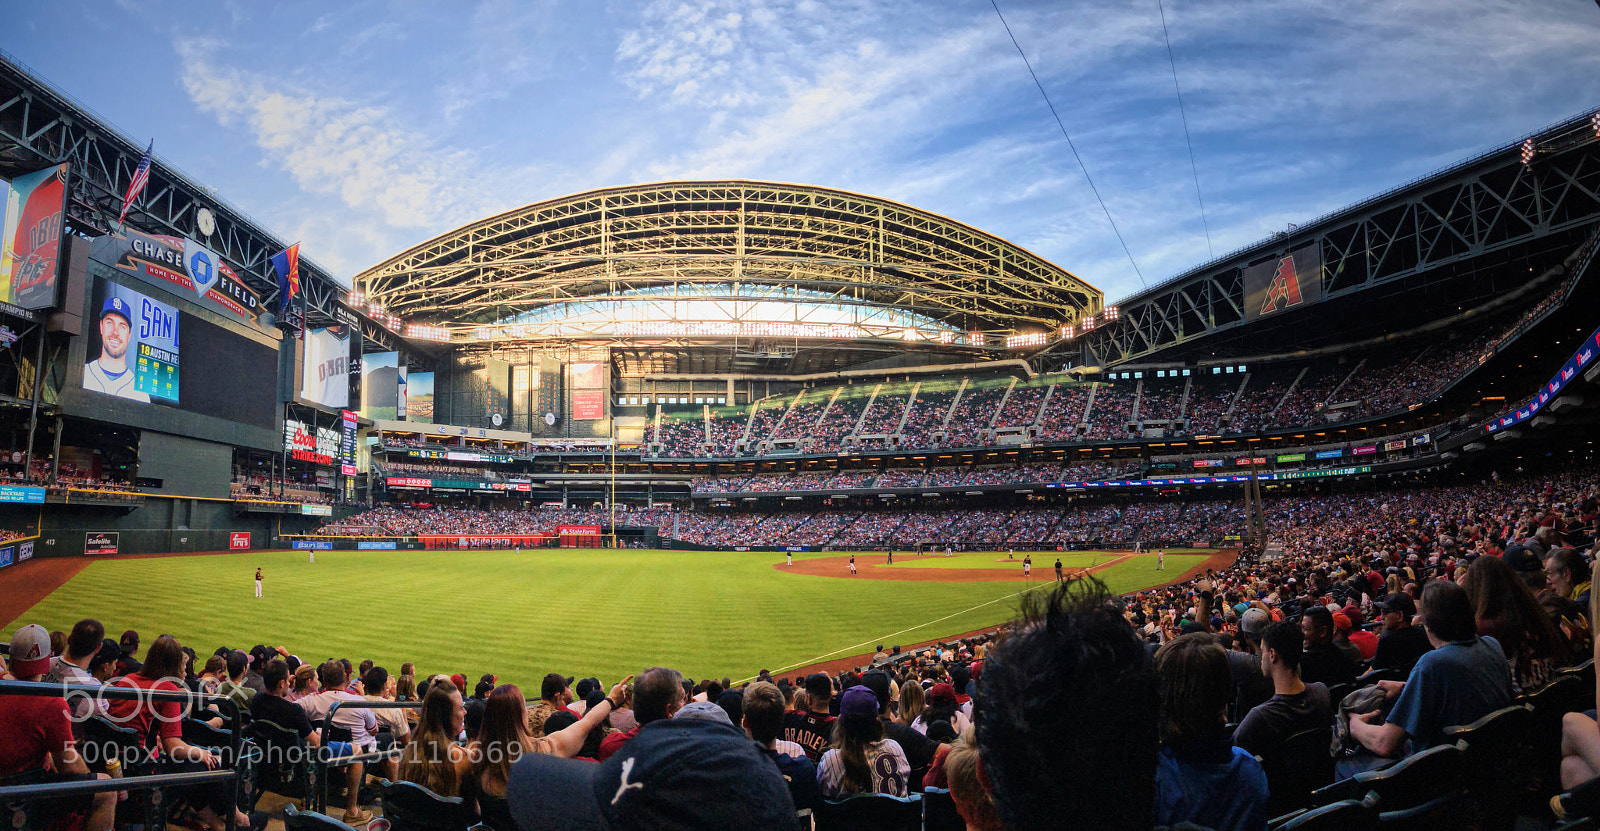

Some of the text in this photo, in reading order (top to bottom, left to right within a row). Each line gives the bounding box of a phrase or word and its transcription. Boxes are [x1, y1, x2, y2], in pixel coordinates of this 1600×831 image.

[132, 239, 256, 308] CHASE FIELD
[149, 267, 244, 314] HOME OF THE DIAMONDBACKS
[1260, 255, 1303, 315] A
[140, 296, 172, 340] SAN
[141, 344, 150, 356] 18
[150, 347, 170, 362] AUSTIN
[292, 449, 332, 465] STRIKE ZONE
[293, 428, 316, 448] Coors
[784, 728, 828, 751] BRADLEY
[874, 752, 903, 798] 8
